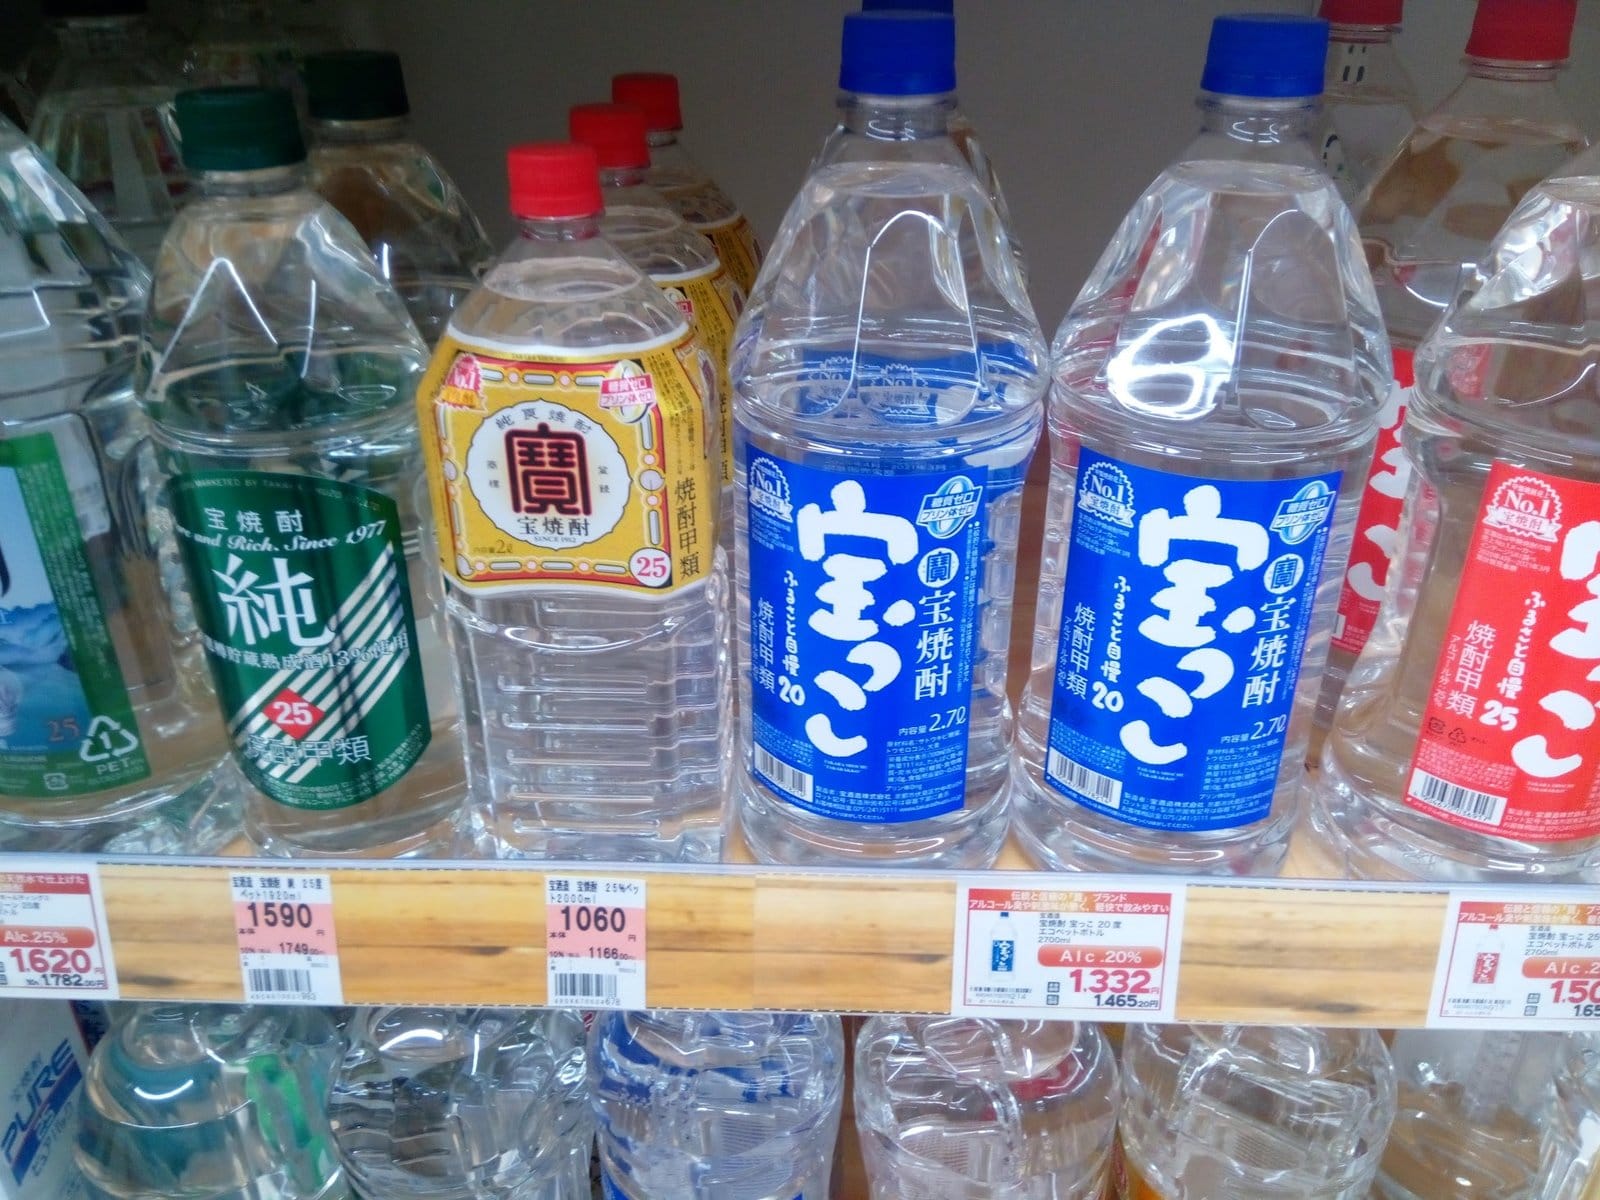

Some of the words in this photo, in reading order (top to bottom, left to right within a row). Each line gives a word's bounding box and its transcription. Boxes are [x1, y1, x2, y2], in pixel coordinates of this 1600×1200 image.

[755, 468, 782, 498] No.1
[1090, 474, 1125, 503] No.1
[1503, 489, 1551, 519] No.1
[203, 507, 304, 533] 宝焼酎
[516, 516, 591, 537] 宝焼酎
[674, 476, 701, 580] 焼酎甲類
[283, 534, 340, 552] Since
[345, 519, 388, 545] 1977
[635, 555, 667, 578] 25
[211, 552, 338, 648] 純
[782, 570, 800, 677] ふるさと自慢
[1100, 575, 1131, 683] ふるさと自慢
[757, 596, 776, 695] 焼酎甲類
[914, 590, 957, 701] 宝焼酎
[1066, 601, 1096, 700] 焼酎甲類
[1242, 596, 1296, 709] 宝焼酎
[1497, 590, 1547, 700] ふるさと自慢
[1445, 619, 1497, 720] 焼酎甲類
[777, 675, 806, 706] 20
[1091, 681, 1125, 713] 20
[273, 701, 314, 726] 25
[1478, 699, 1520, 732] 25
[898, 724, 927, 737] 内容量
[96, 756, 132, 775] PET
[247, 902, 313, 928] 1590
[560, 905, 626, 933] 1060
[1038, 920, 1066, 929] 宝焼酎
[1069, 920, 1094, 929] 宝っこ
[627, 934, 637, 943] 円
[1037, 936, 1072, 944] 2700ml
[1038, 928, 1105, 937] エコペットボトル
[1525, 941, 1593, 950] エコペットボトル
[1, 1038, 77, 1165] PURE
